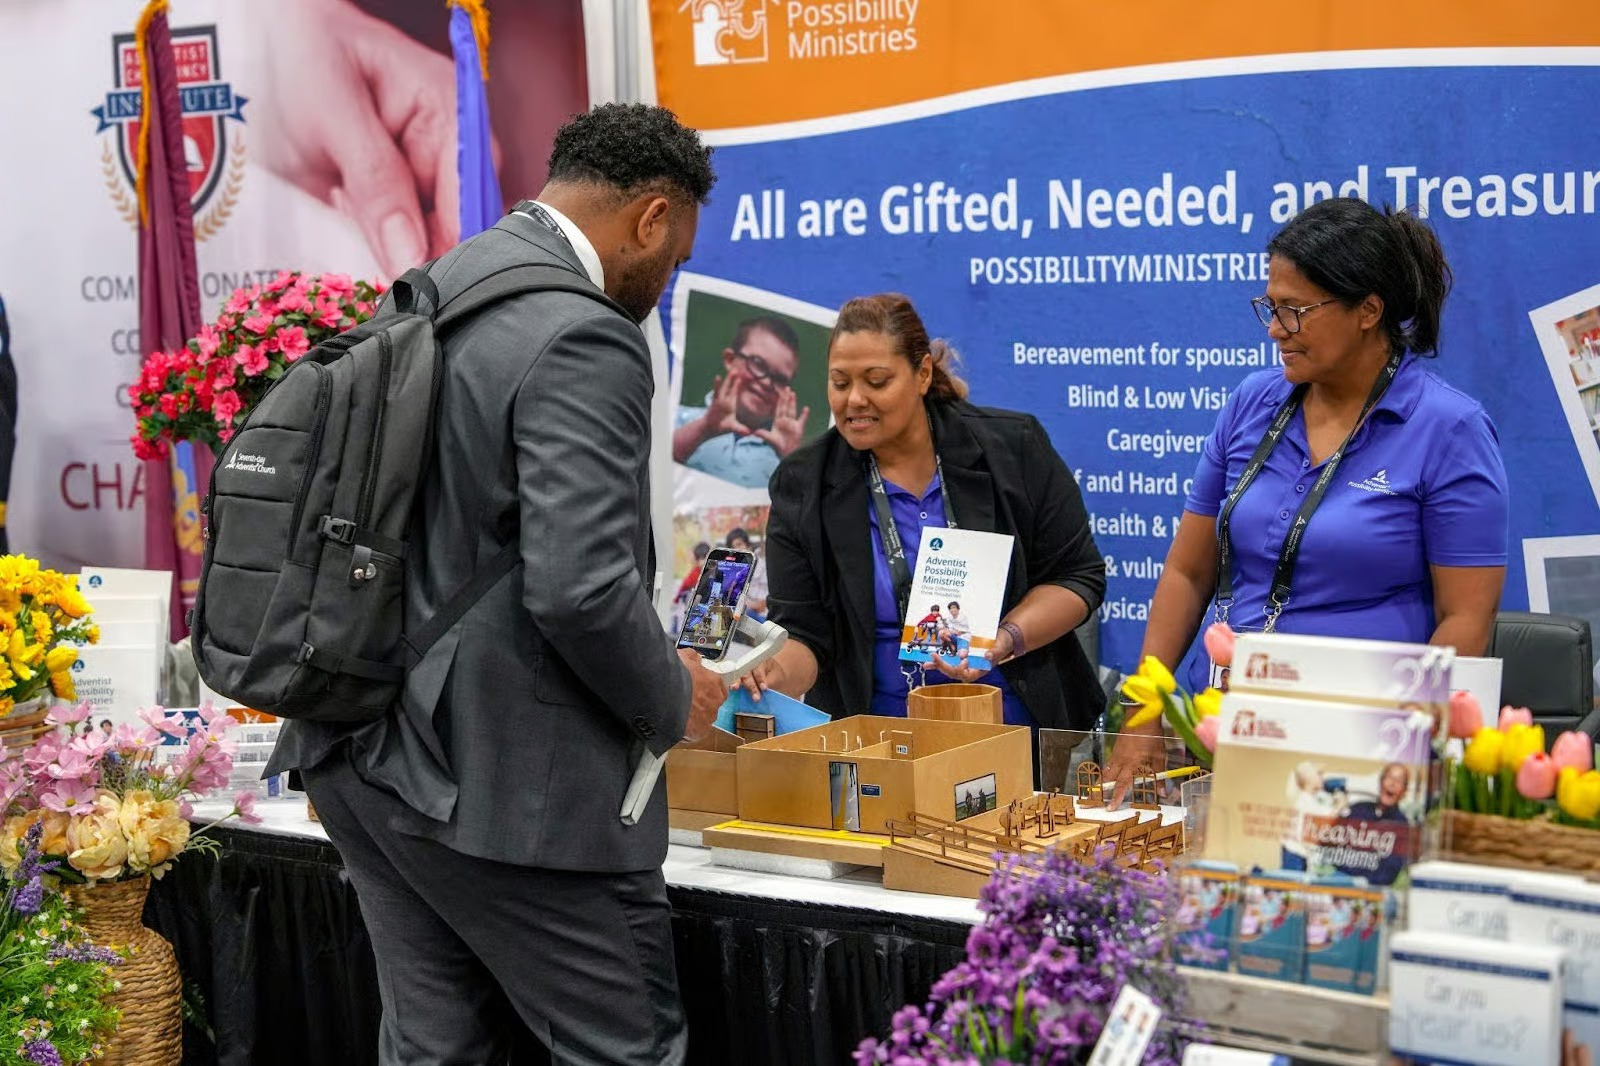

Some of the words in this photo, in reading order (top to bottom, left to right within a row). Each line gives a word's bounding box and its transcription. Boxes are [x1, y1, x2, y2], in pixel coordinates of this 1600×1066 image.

[787, 0, 919, 28] Possibility
[788, 24, 917, 58] Ministries
[731, 189, 785, 241] All
[797, 198, 867, 238] are
[880, 178, 1033, 239] Gifted,
[1048, 170, 1254, 233] Needed,
[1270, 165, 1368, 224] and
[1386, 166, 1600, 219] Treasur
[970, 252, 1269, 285] POSSIBILITYMINISTRIE
[1014, 343, 1145, 366] Bereavement
[1151, 343, 1180, 366] for
[1186, 342, 1265, 372] spousal
[1068, 385, 1118, 408] Blind
[1125, 386, 1139, 409] &
[1145, 387, 1185, 409] Low
[1107, 429, 1207, 458] Caregiver
[1086, 470, 1124, 493] and
[1129, 472, 1178, 496] Hard
[1152, 515, 1167, 537] &
[924, 565, 968, 580] Possibility
[926, 556, 967, 568] Adventist
[1104, 555, 1118, 577] &
[1122, 556, 1164, 579] vuln
[922, 575, 965, 587] Ministries
